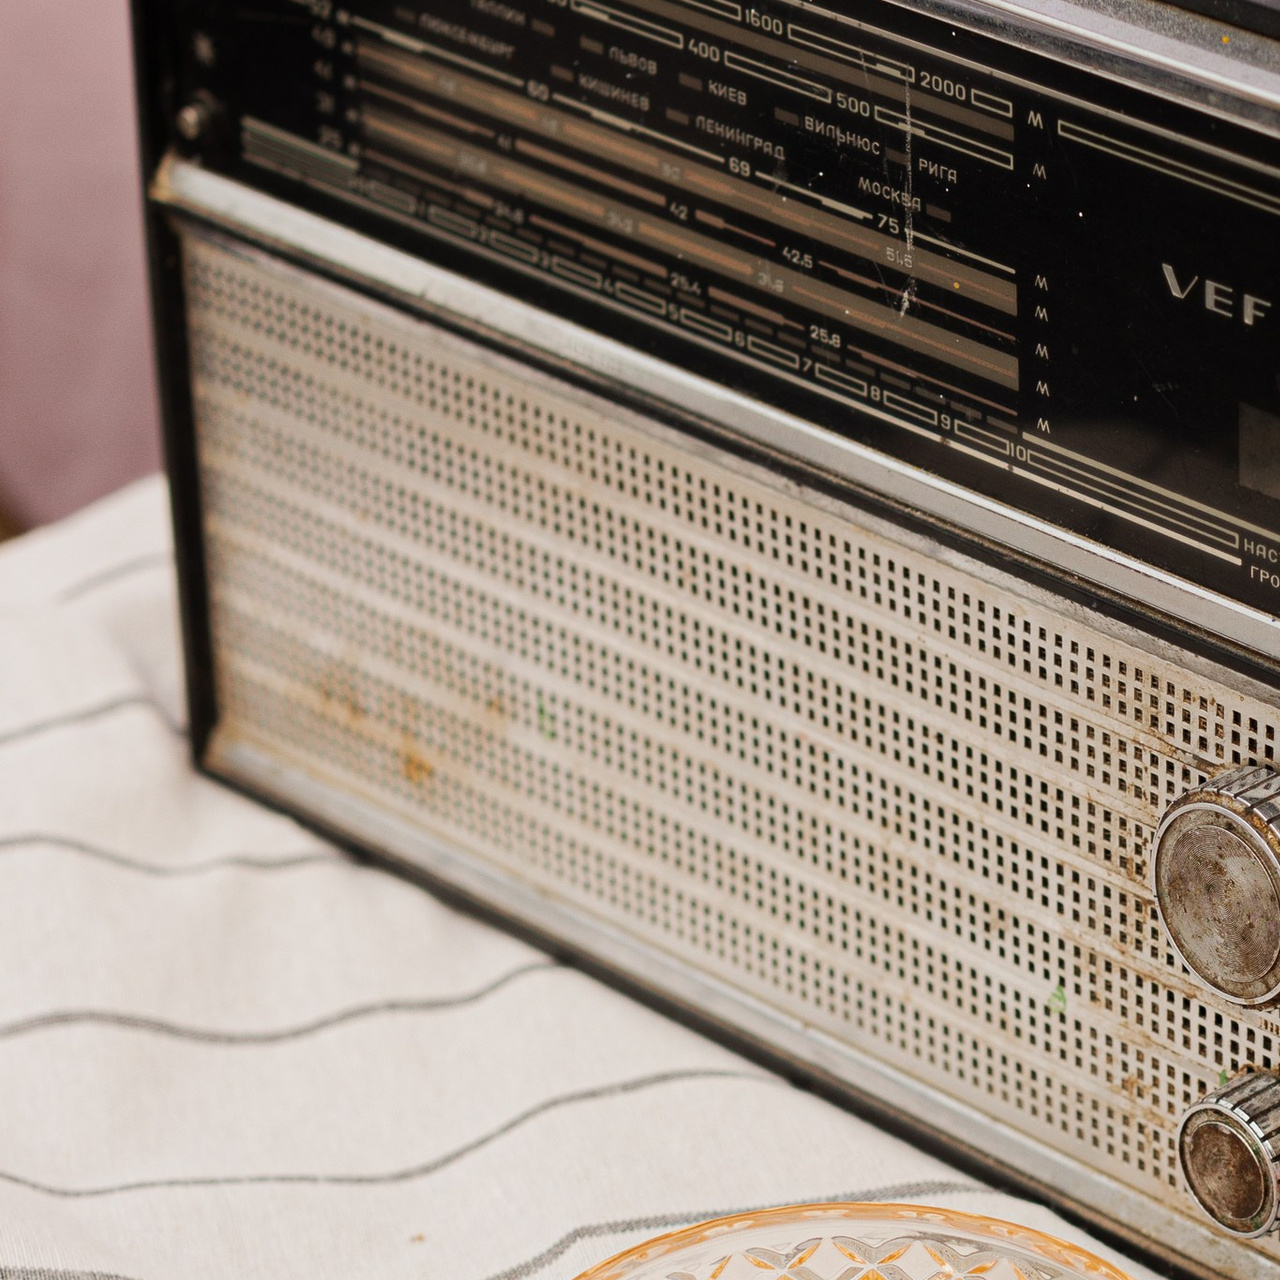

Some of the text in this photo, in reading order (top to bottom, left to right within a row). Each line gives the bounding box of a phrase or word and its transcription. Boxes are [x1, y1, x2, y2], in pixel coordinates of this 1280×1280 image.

[688, 38, 720, 63] 400
[836, 91, 870, 118] 500
[745, 9, 783, 36] 1600
[920, 71, 966, 101] 2000
[527, 79, 550, 101] 60
[728, 156, 751, 177] 69
[877, 213, 900, 235] 75
[578, 73, 650, 111] КИШИНЕВ
[695, 115, 787, 161] ЛЕНИНГРАД
[857, 176, 922, 212] МОСКВА
[609, 45, 658, 75] ЛЬВОВ
[708, 79, 748, 106] КИЕВ
[804, 115, 881, 155] ВИЛЬНЮС
[918, 158, 958, 185] РИГА
[669, 200, 688, 222] 42
[1162, 262, 1272, 326] VEF
[604, 276, 614, 294] 4
[668, 303, 680, 321] 5
[734, 331, 746, 348] 6
[802, 357, 812, 373] 7
[870, 385, 881, 402] 8
[940, 413, 951, 431] 9
[1010, 442, 1027, 461] 10
